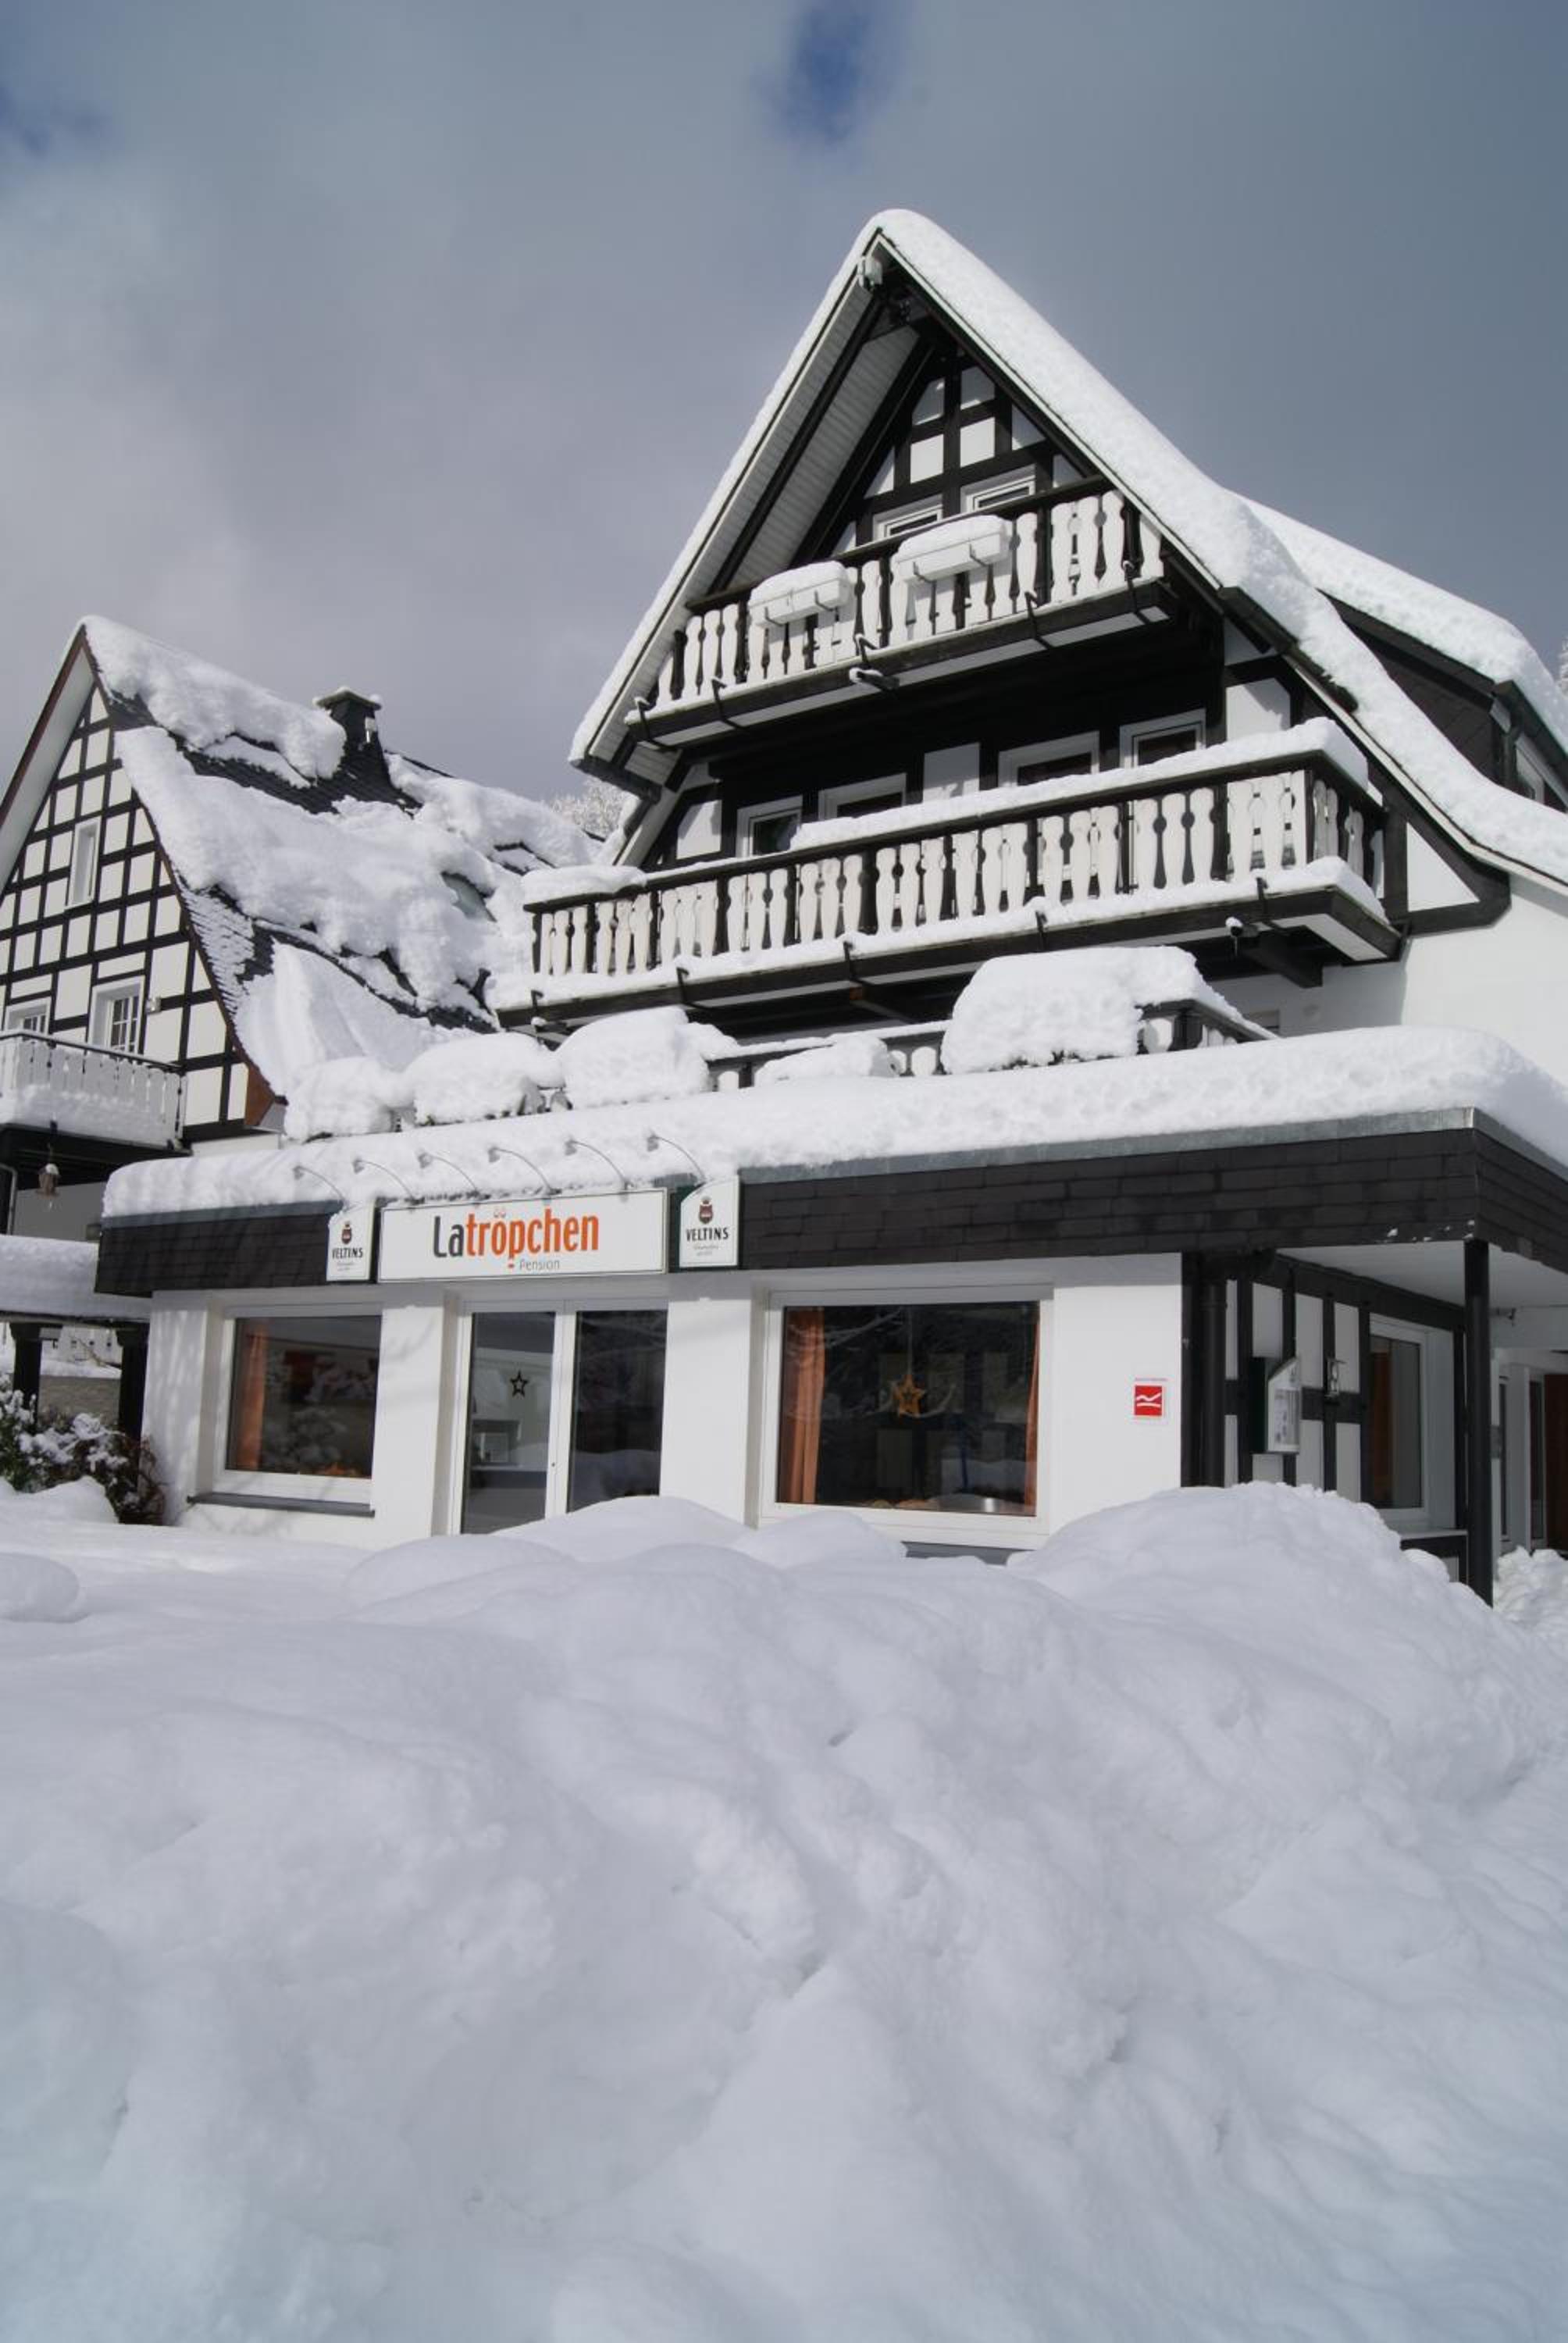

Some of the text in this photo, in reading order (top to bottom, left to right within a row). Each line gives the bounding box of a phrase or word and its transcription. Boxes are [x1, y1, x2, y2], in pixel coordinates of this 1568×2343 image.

[433, 1207, 599, 1259] Latröpchen
[686, 1227, 729, 1242] VELTINS
[331, 1247, 363, 1259] VELTINS
[519, 1259, 560, 1271] Pension
